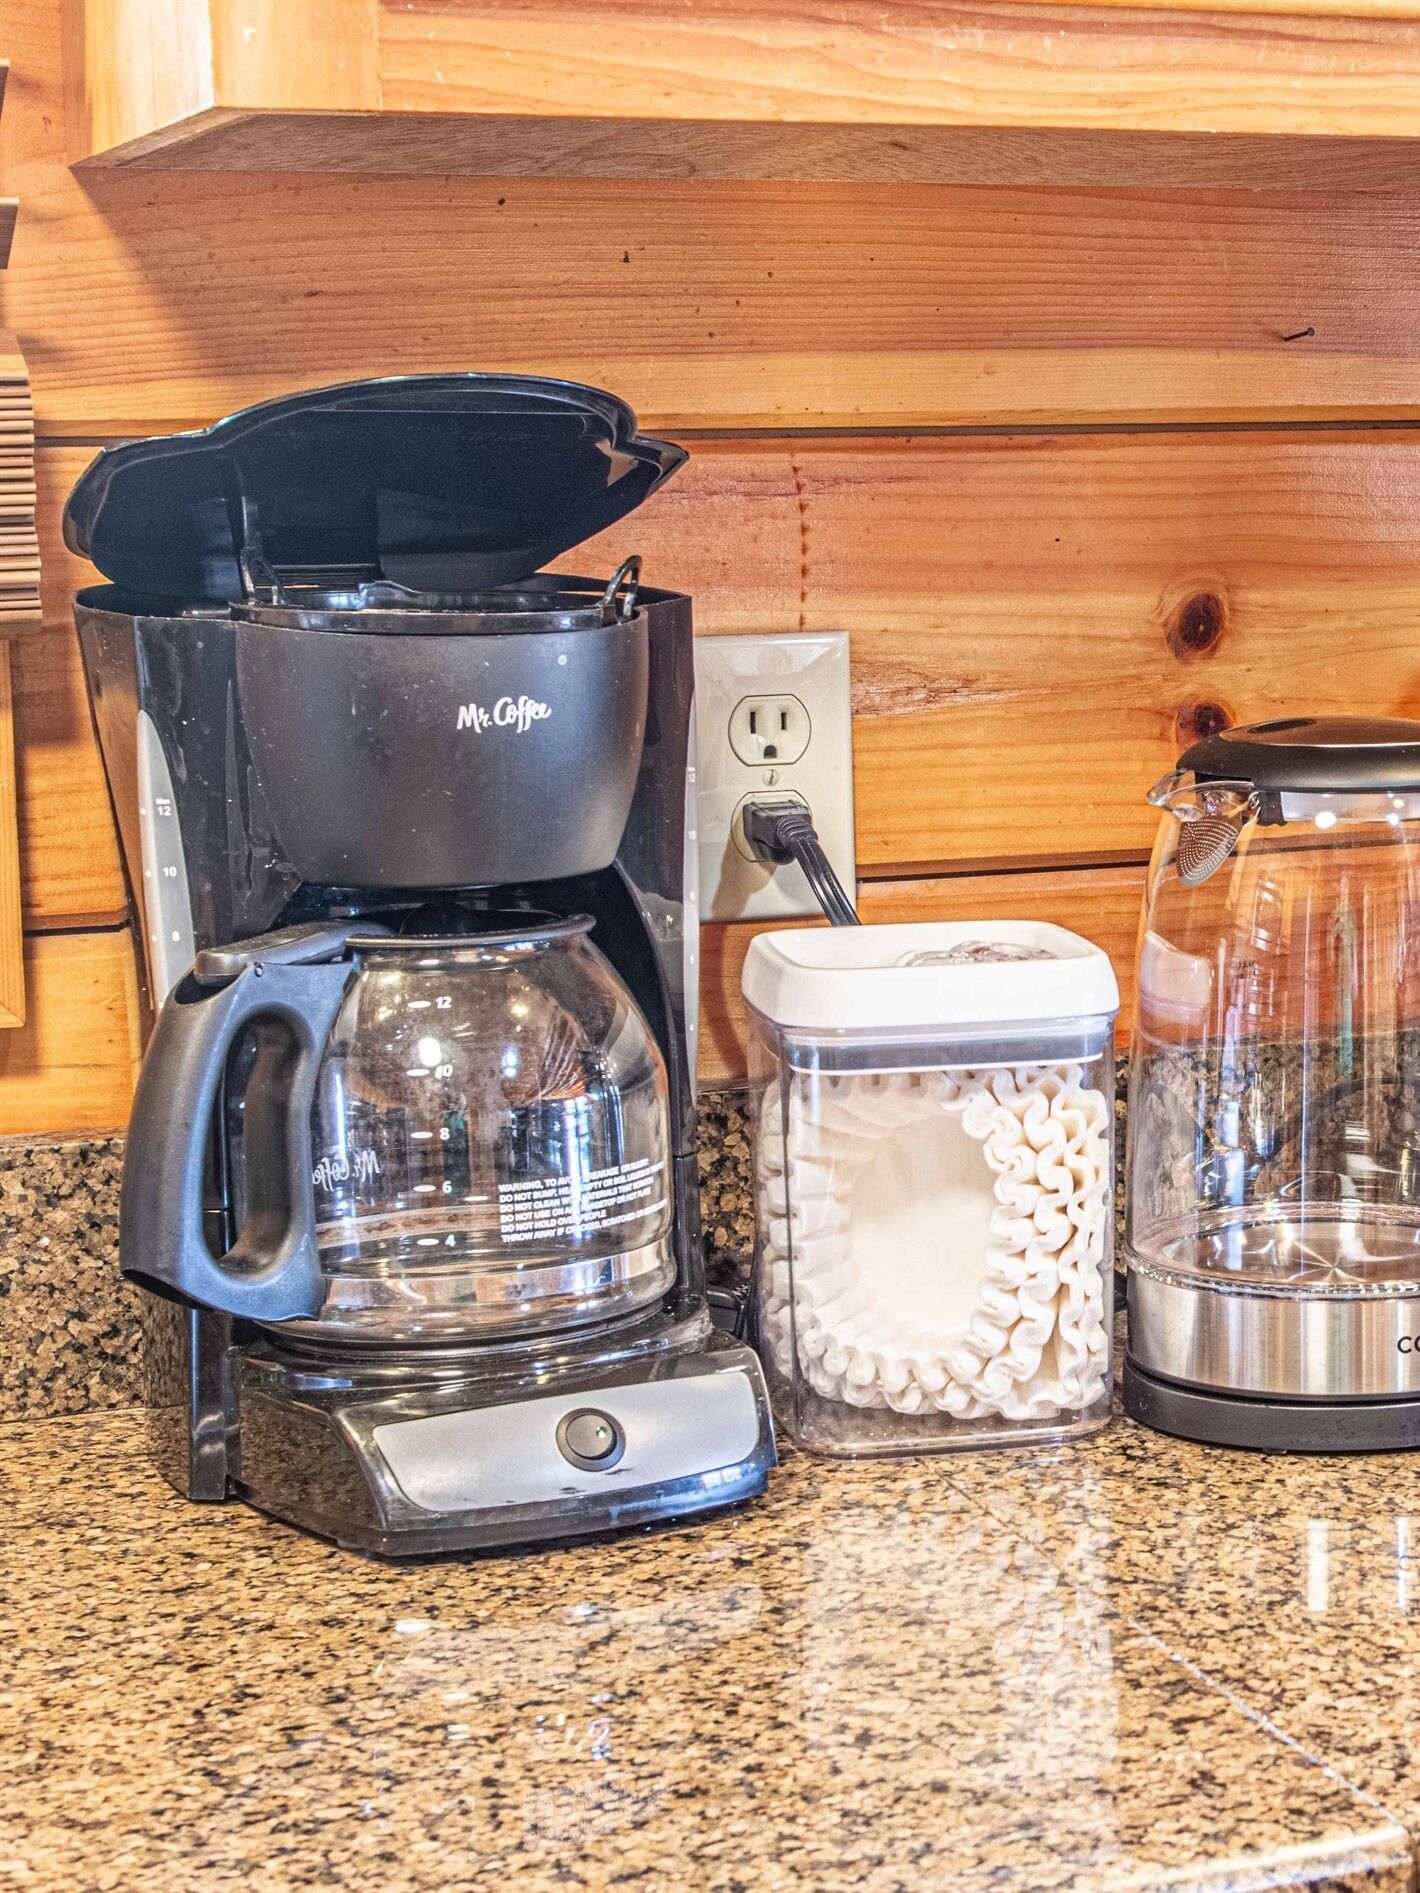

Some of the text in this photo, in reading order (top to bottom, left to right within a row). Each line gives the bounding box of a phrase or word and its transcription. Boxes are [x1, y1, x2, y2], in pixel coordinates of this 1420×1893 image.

[456, 695, 552, 733] Mr. Coffee
[157, 805, 172, 817] 12
[163, 866, 178, 878] 10
[172, 930, 181, 942] 8
[435, 996, 452, 1009] 12
[435, 1064, 453, 1079] 10
[440, 1128, 450, 1140] 8
[442, 1181, 452, 1193] 6
[544, 1178, 557, 1187] TO
[499, 1194, 513, 1203] DO
[514, 1192, 532, 1202] NOT
[499, 1204, 514, 1213] DO
[514, 1202, 532, 1211] NOT
[533, 1199, 560, 1209] CLEAN
[500, 1214, 514, 1223] DO
[515, 1212, 533, 1221] NOT
[534, 1209, 551, 1219] USE
[551, 1207, 564, 1216] ON
[501, 1225, 515, 1233] DO
[515, 1222, 534, 1231] NOT
[534, 1219, 557, 1229] HOLD
[445, 1235, 456, 1247] 4
[501, 1232, 533, 1243] THROW
[533, 1228, 556, 1239] AWAY
[557, 1227, 565, 1236] IF
